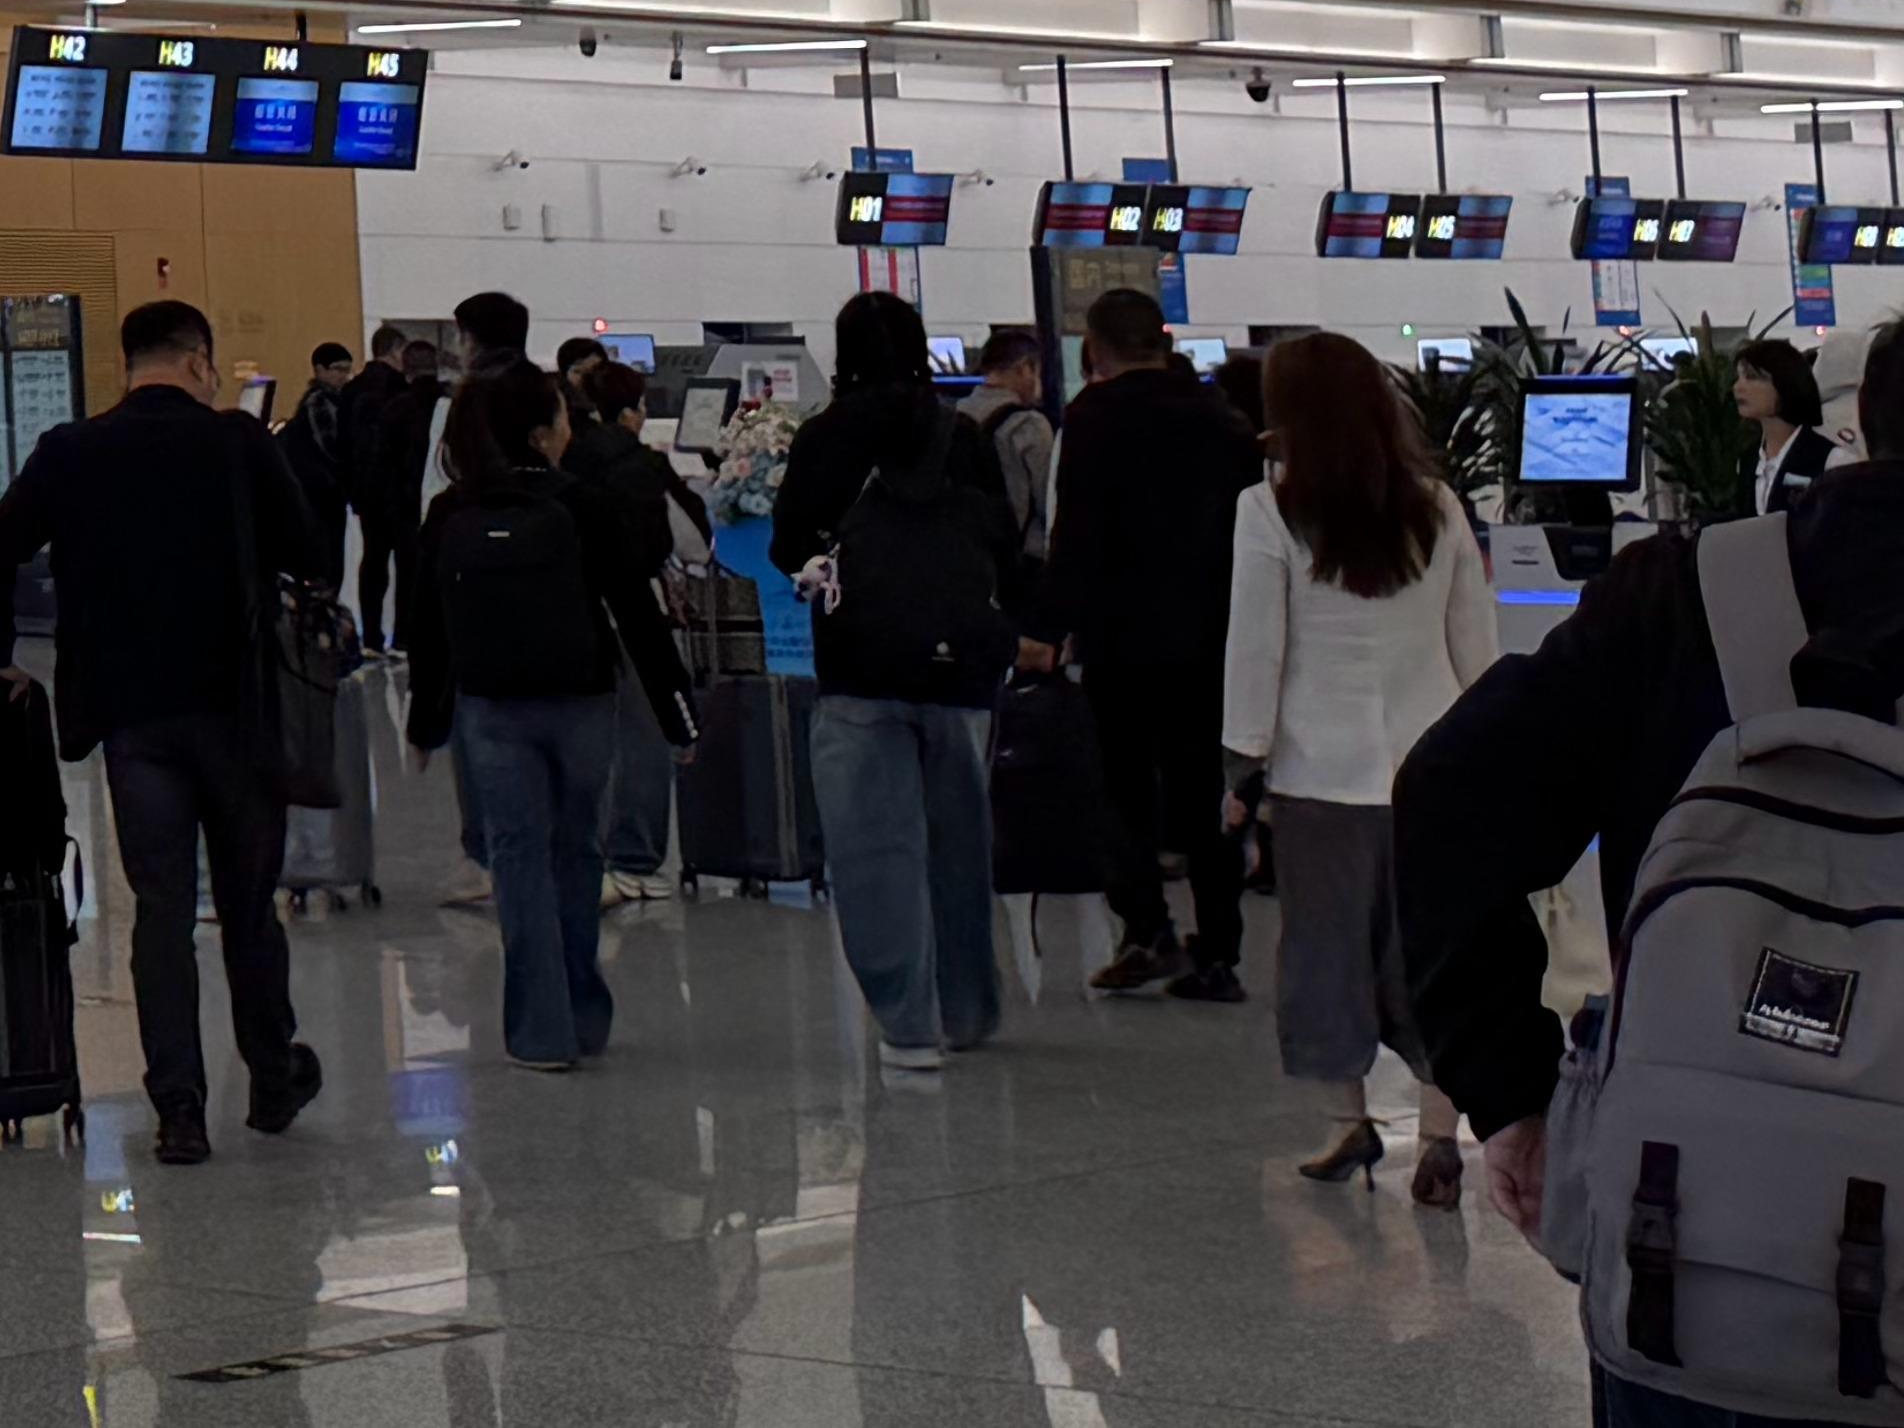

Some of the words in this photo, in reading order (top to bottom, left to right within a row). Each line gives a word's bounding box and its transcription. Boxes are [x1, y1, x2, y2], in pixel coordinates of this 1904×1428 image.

[49, 34, 86, 61] H42
[158, 40, 194, 67] H43
[263, 46, 298, 72] H44
[367, 52, 400, 77] H45
[850, 196, 883, 222] H01
[1110, 206, 1141, 231] H02
[1153, 206, 1184, 231] H03
[1386, 214, 1415, 239] H04
